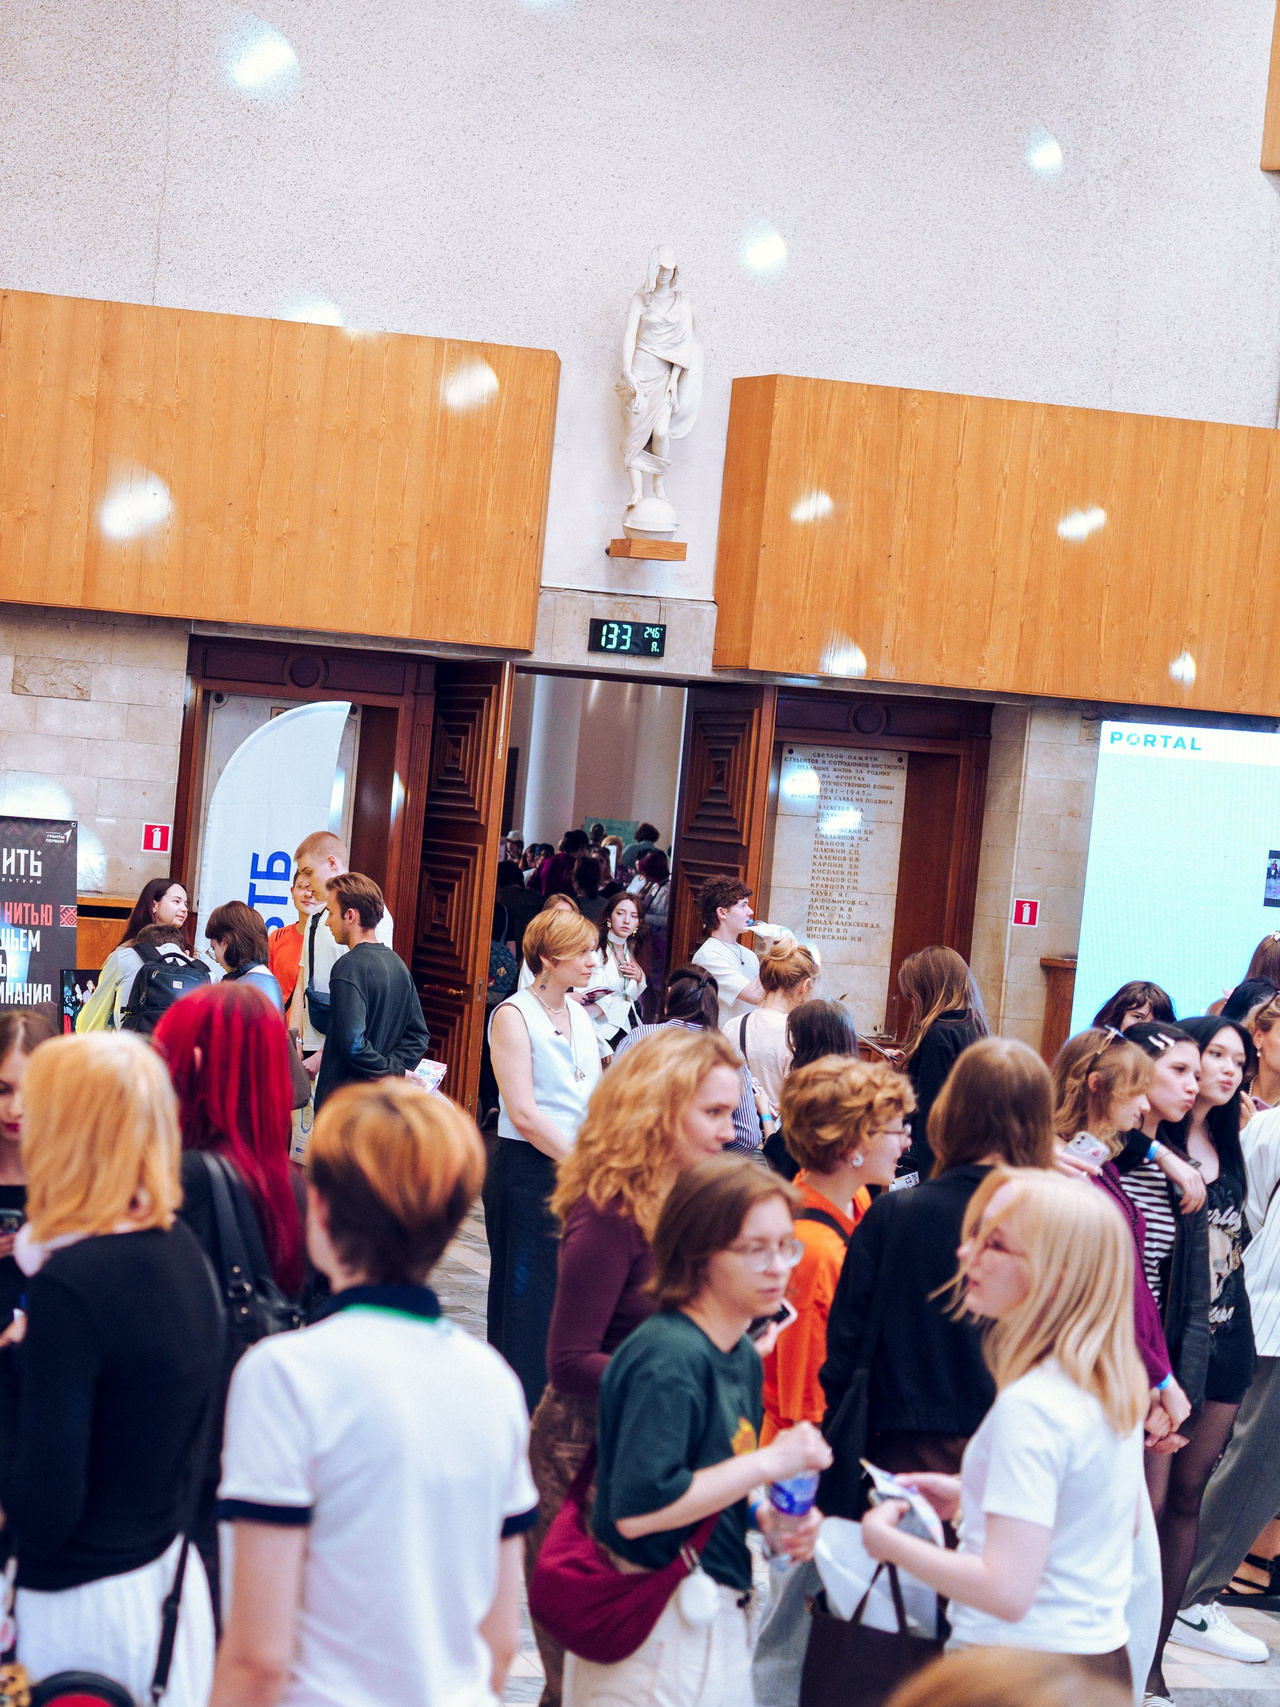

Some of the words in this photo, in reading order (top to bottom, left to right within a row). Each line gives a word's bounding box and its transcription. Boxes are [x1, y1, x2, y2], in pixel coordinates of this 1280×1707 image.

[1110, 731, 1202, 751] PORTAL
[784, 756, 819, 764] СТУДЕНТОВ
[848, 754, 878, 762] ПАМЯТИ
[4, 902, 53, 926] НИТЬЮ
